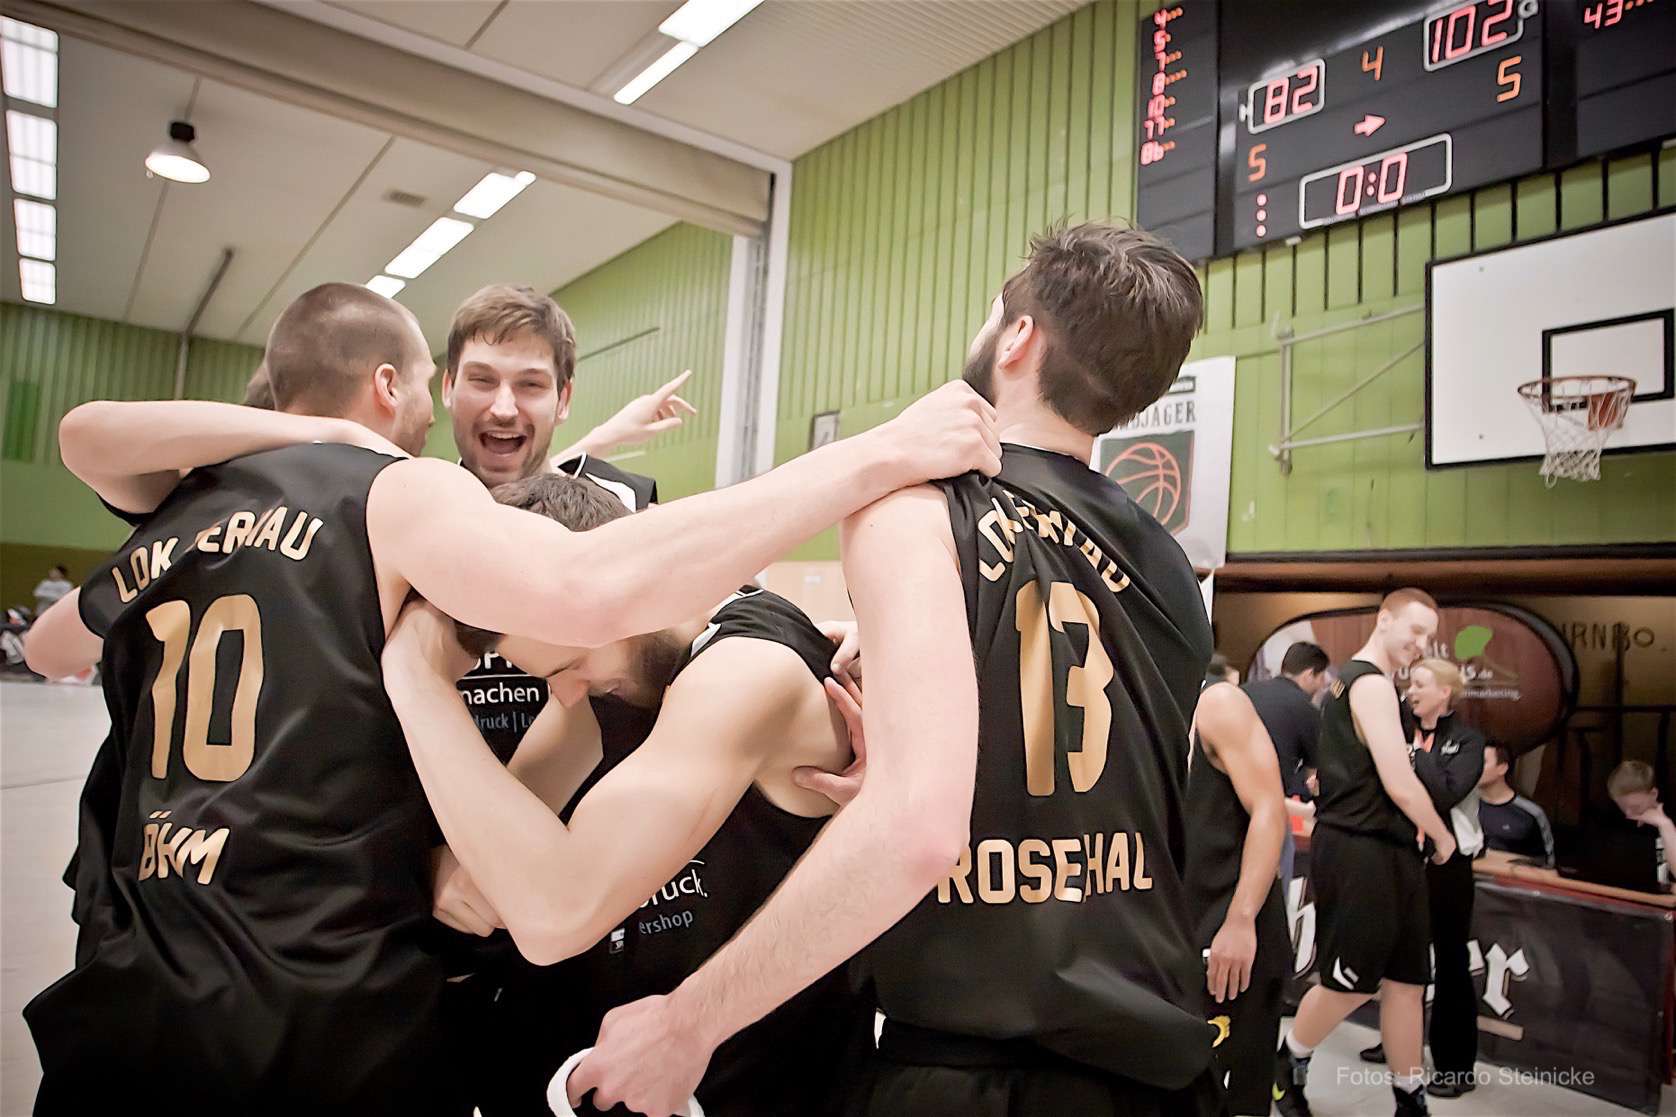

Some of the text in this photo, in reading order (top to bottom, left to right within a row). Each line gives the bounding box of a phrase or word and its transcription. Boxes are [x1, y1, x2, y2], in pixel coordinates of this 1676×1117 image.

[1431, 0, 1515, 64] 102
[1583, 0, 1624, 29] 43
[1263, 66, 1318, 125] 82
[1361, 46, 1384, 81] 4
[1496, 55, 1522, 103] 5
[1247, 144, 1267, 183] 5
[1335, 151, 1409, 215] 0:0
[111, 536, 179, 603] LOK
[145, 593, 265, 783] 10
[1015, 580, 1115, 797] 13
[475, 711, 508, 730] ruck
[138, 810, 230, 885] ÖHM
[937, 832, 1153, 904] ROSEHAL
